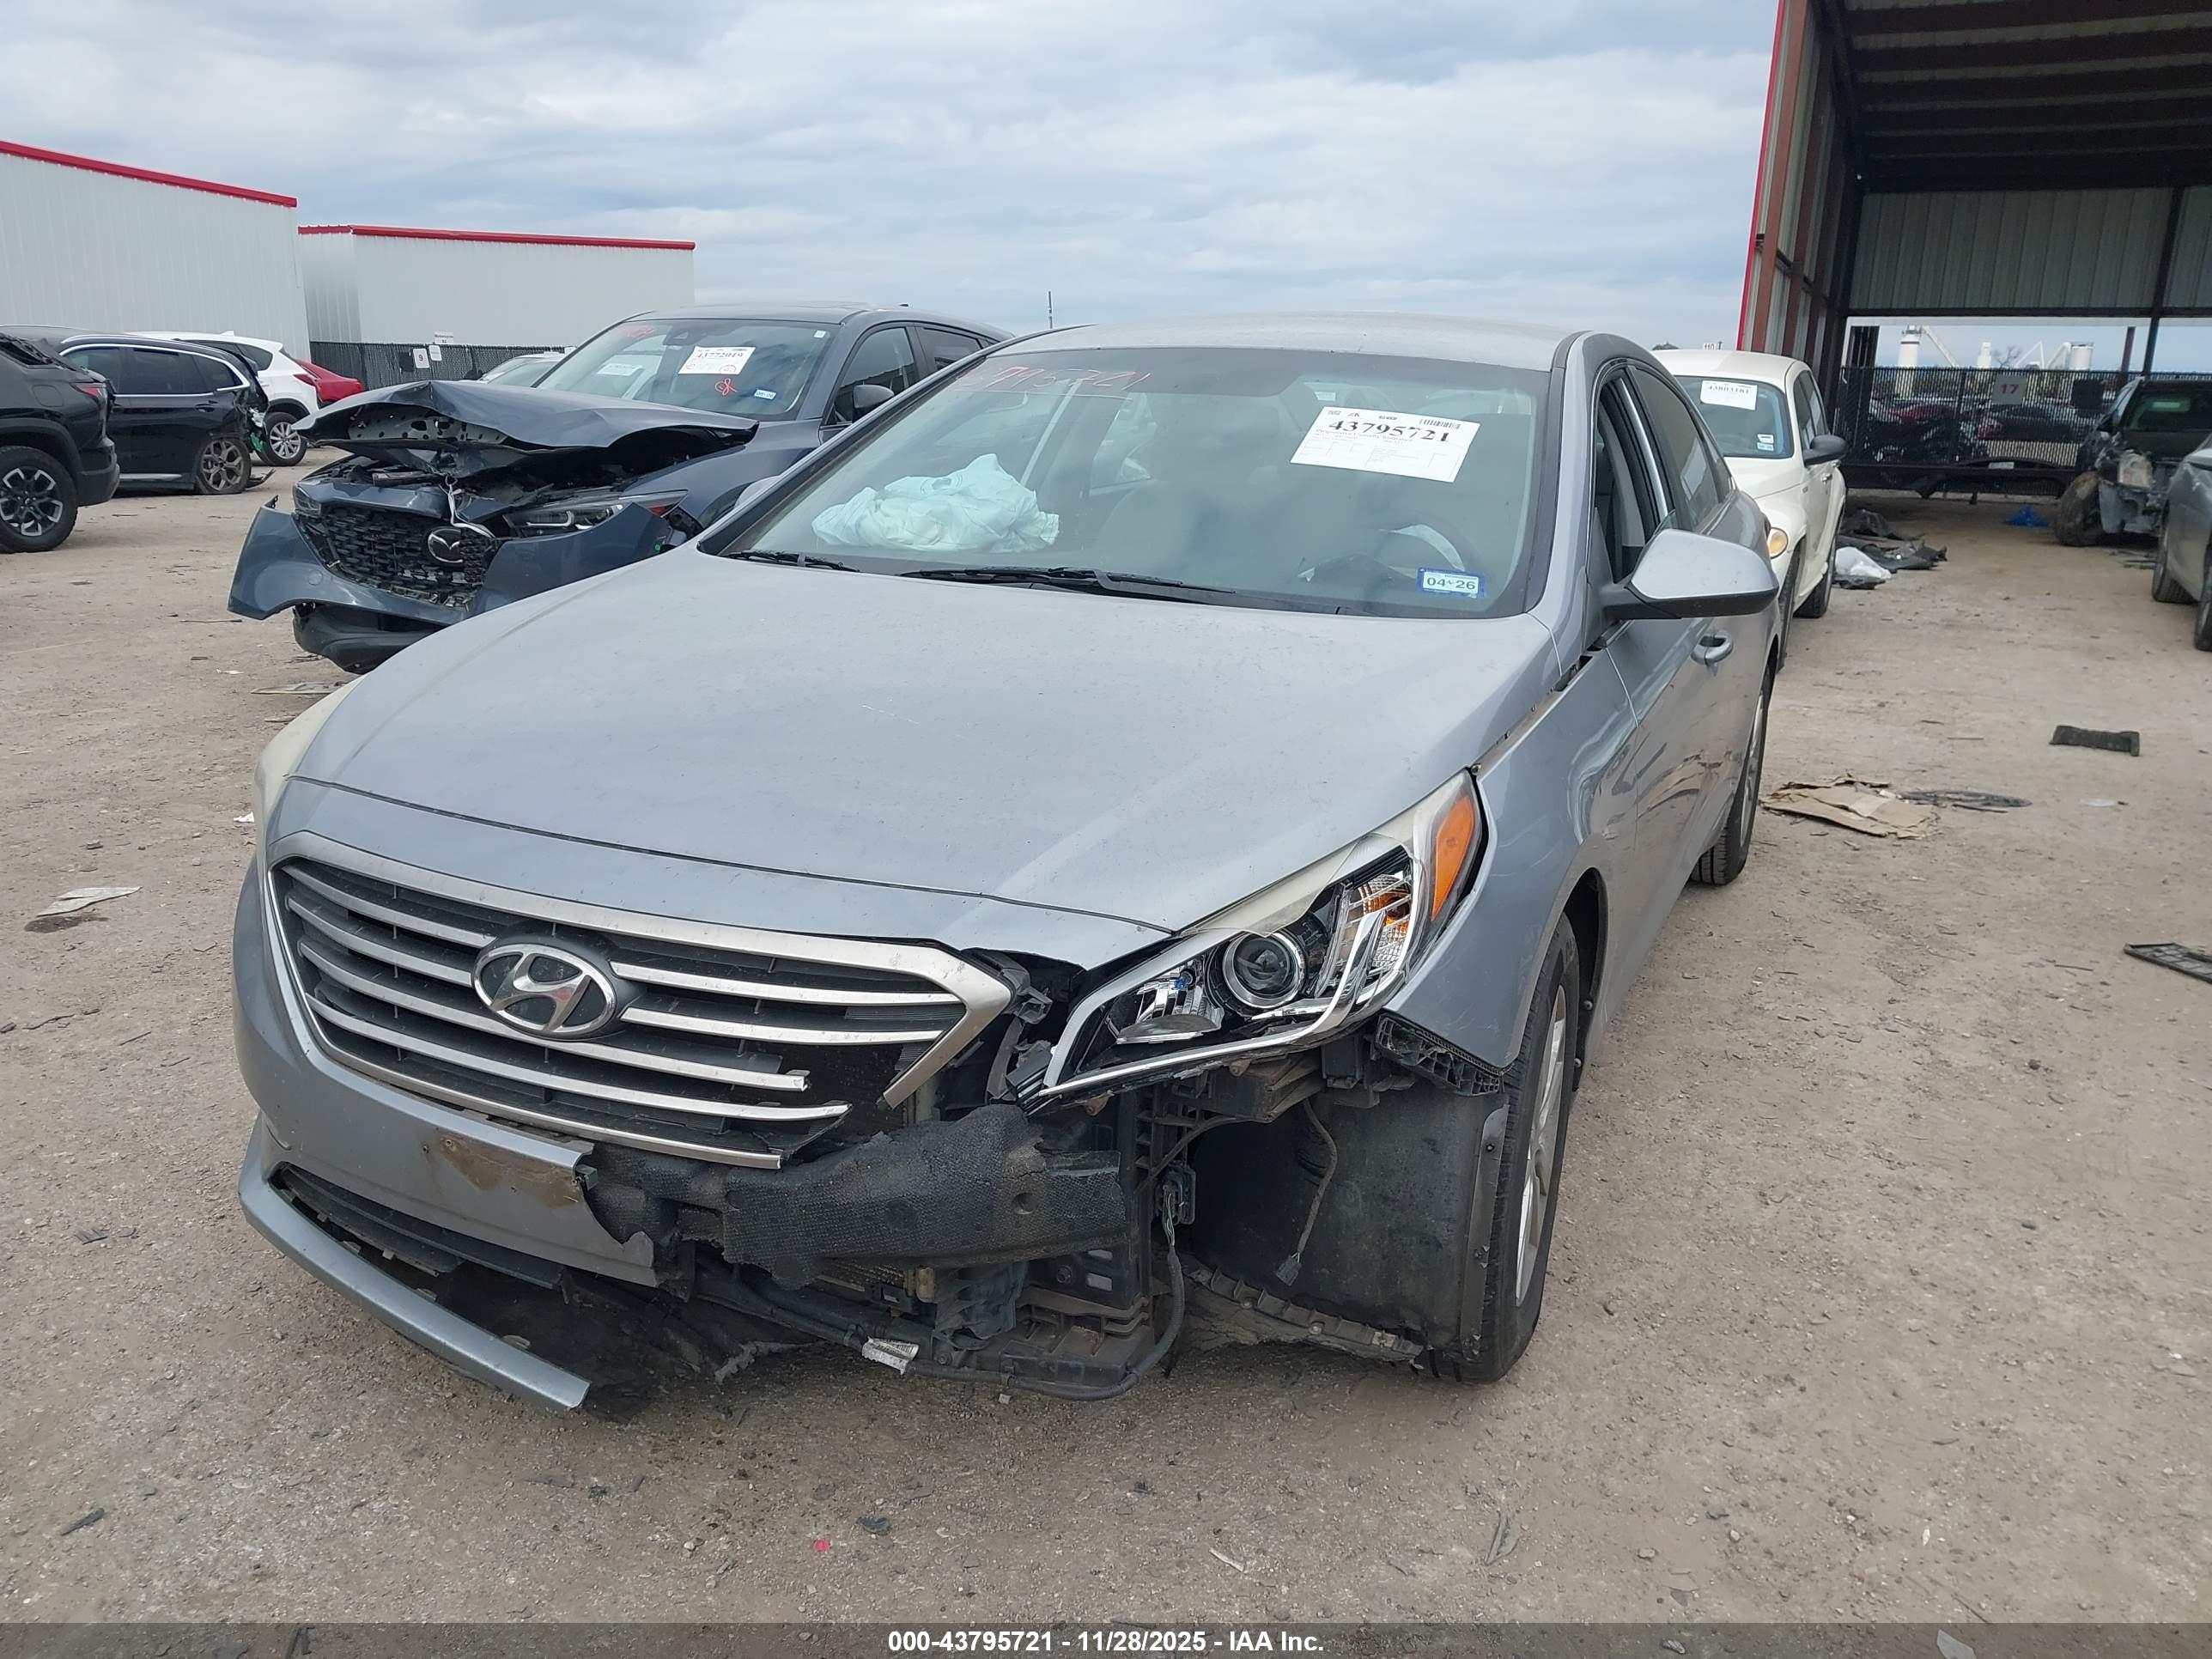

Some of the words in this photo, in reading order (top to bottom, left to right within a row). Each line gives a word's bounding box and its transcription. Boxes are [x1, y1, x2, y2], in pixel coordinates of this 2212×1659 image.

[1999, 384, 2020, 394] 17
[1328, 420, 1449, 442] 43795721
[1426, 577, 1446, 586] 04
[1455, 580, 1476, 590] 26
